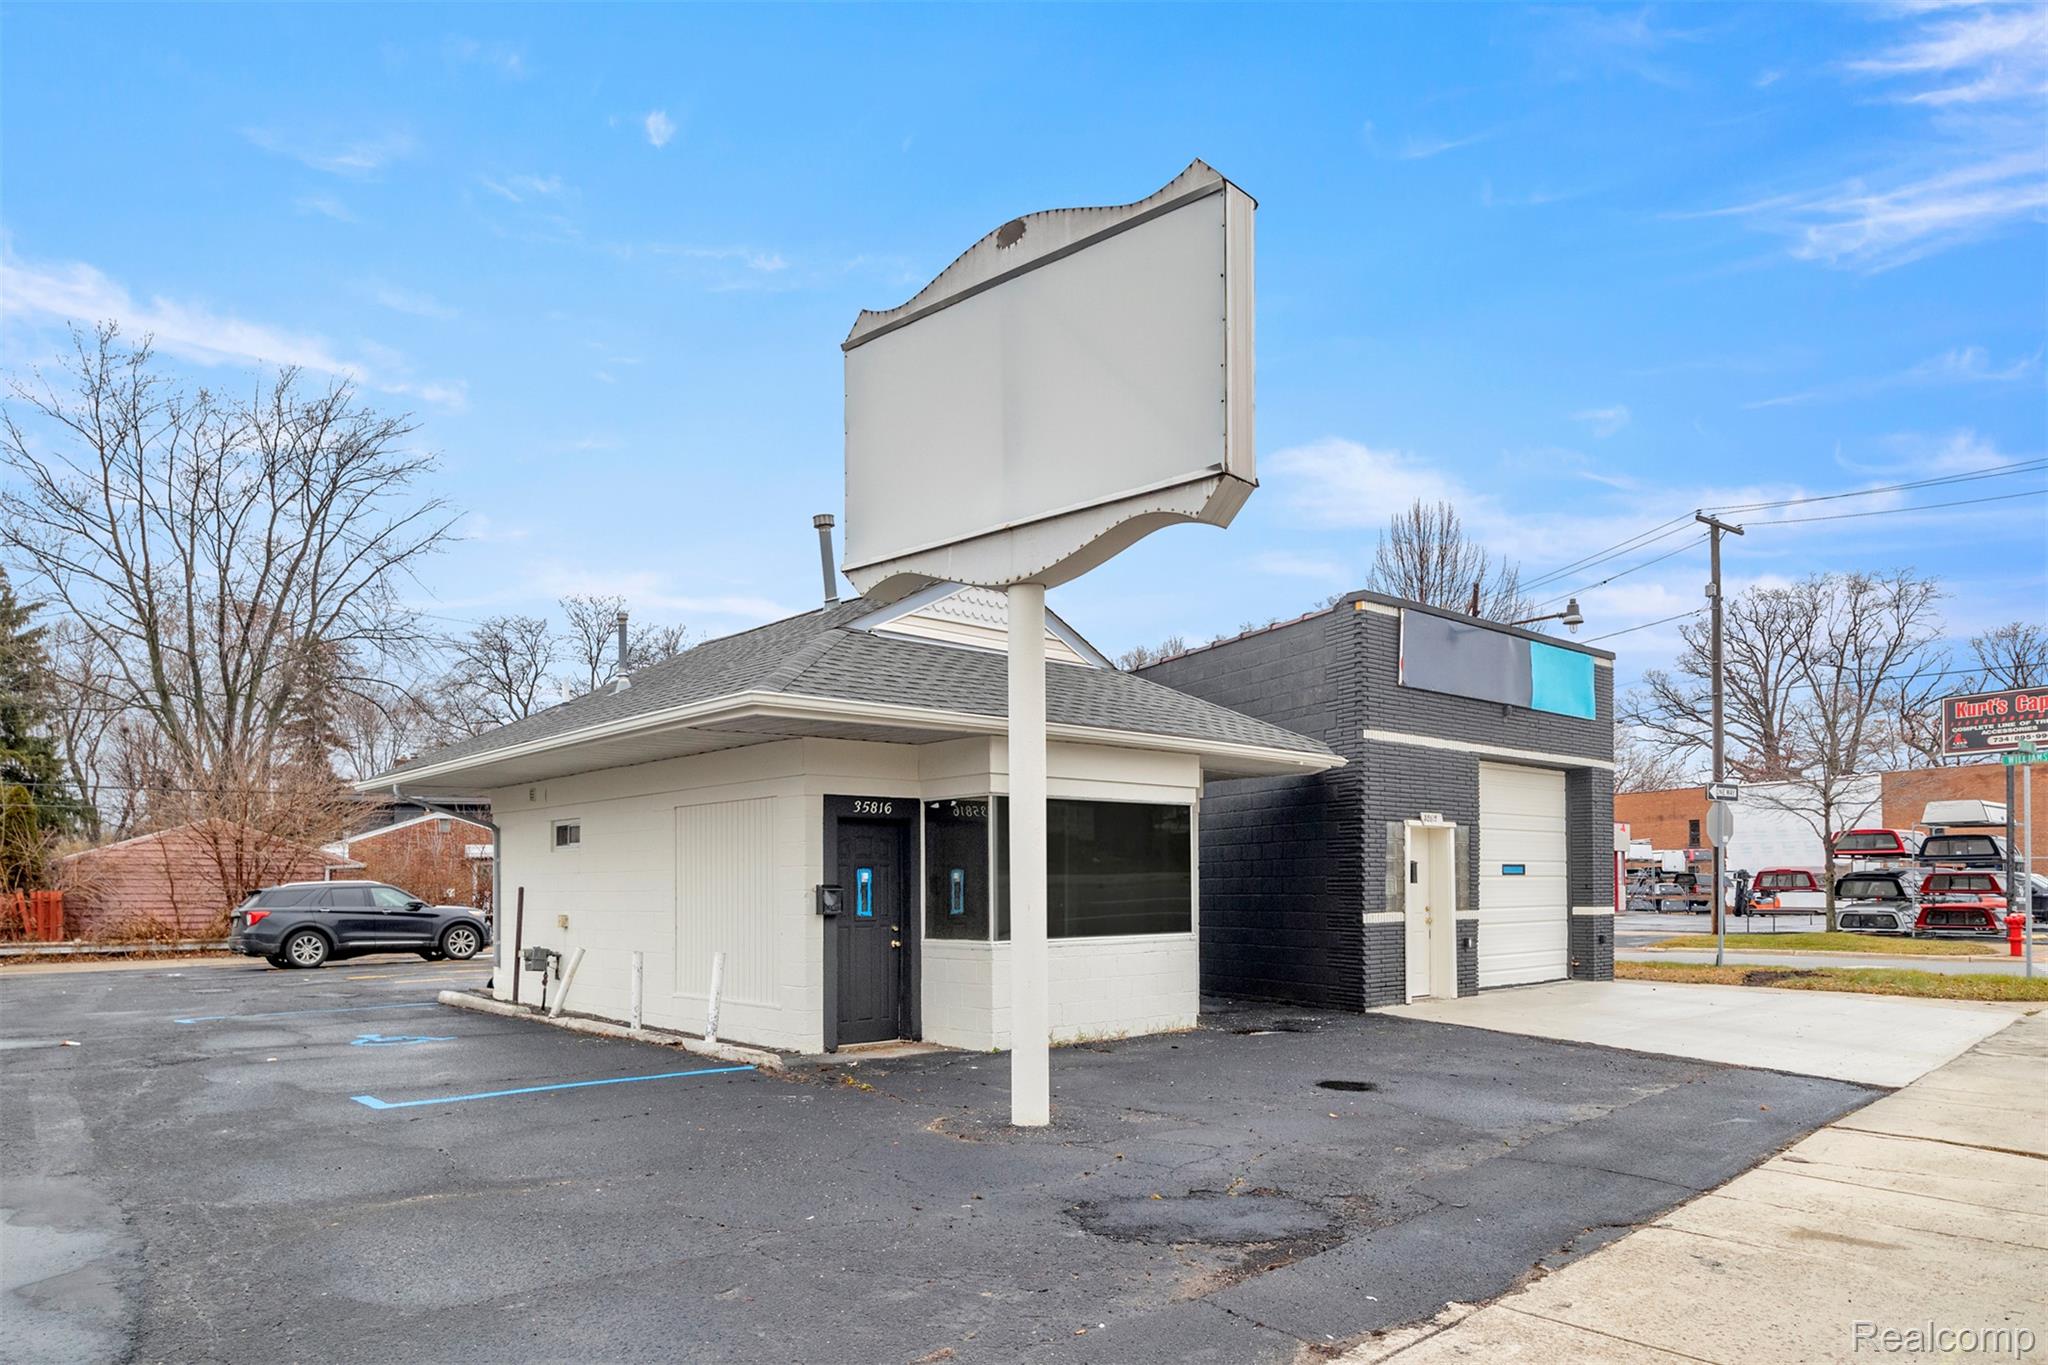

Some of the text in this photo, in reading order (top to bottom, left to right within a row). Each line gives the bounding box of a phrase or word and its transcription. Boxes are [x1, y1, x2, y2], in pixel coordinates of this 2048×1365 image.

[1955, 694, 2048, 718] Kurt's Cap
[1952, 724, 1994, 733] COMPLETE
[1981, 726, 2038, 735] ACCESSORIES
[853, 800, 892, 815] 35816
